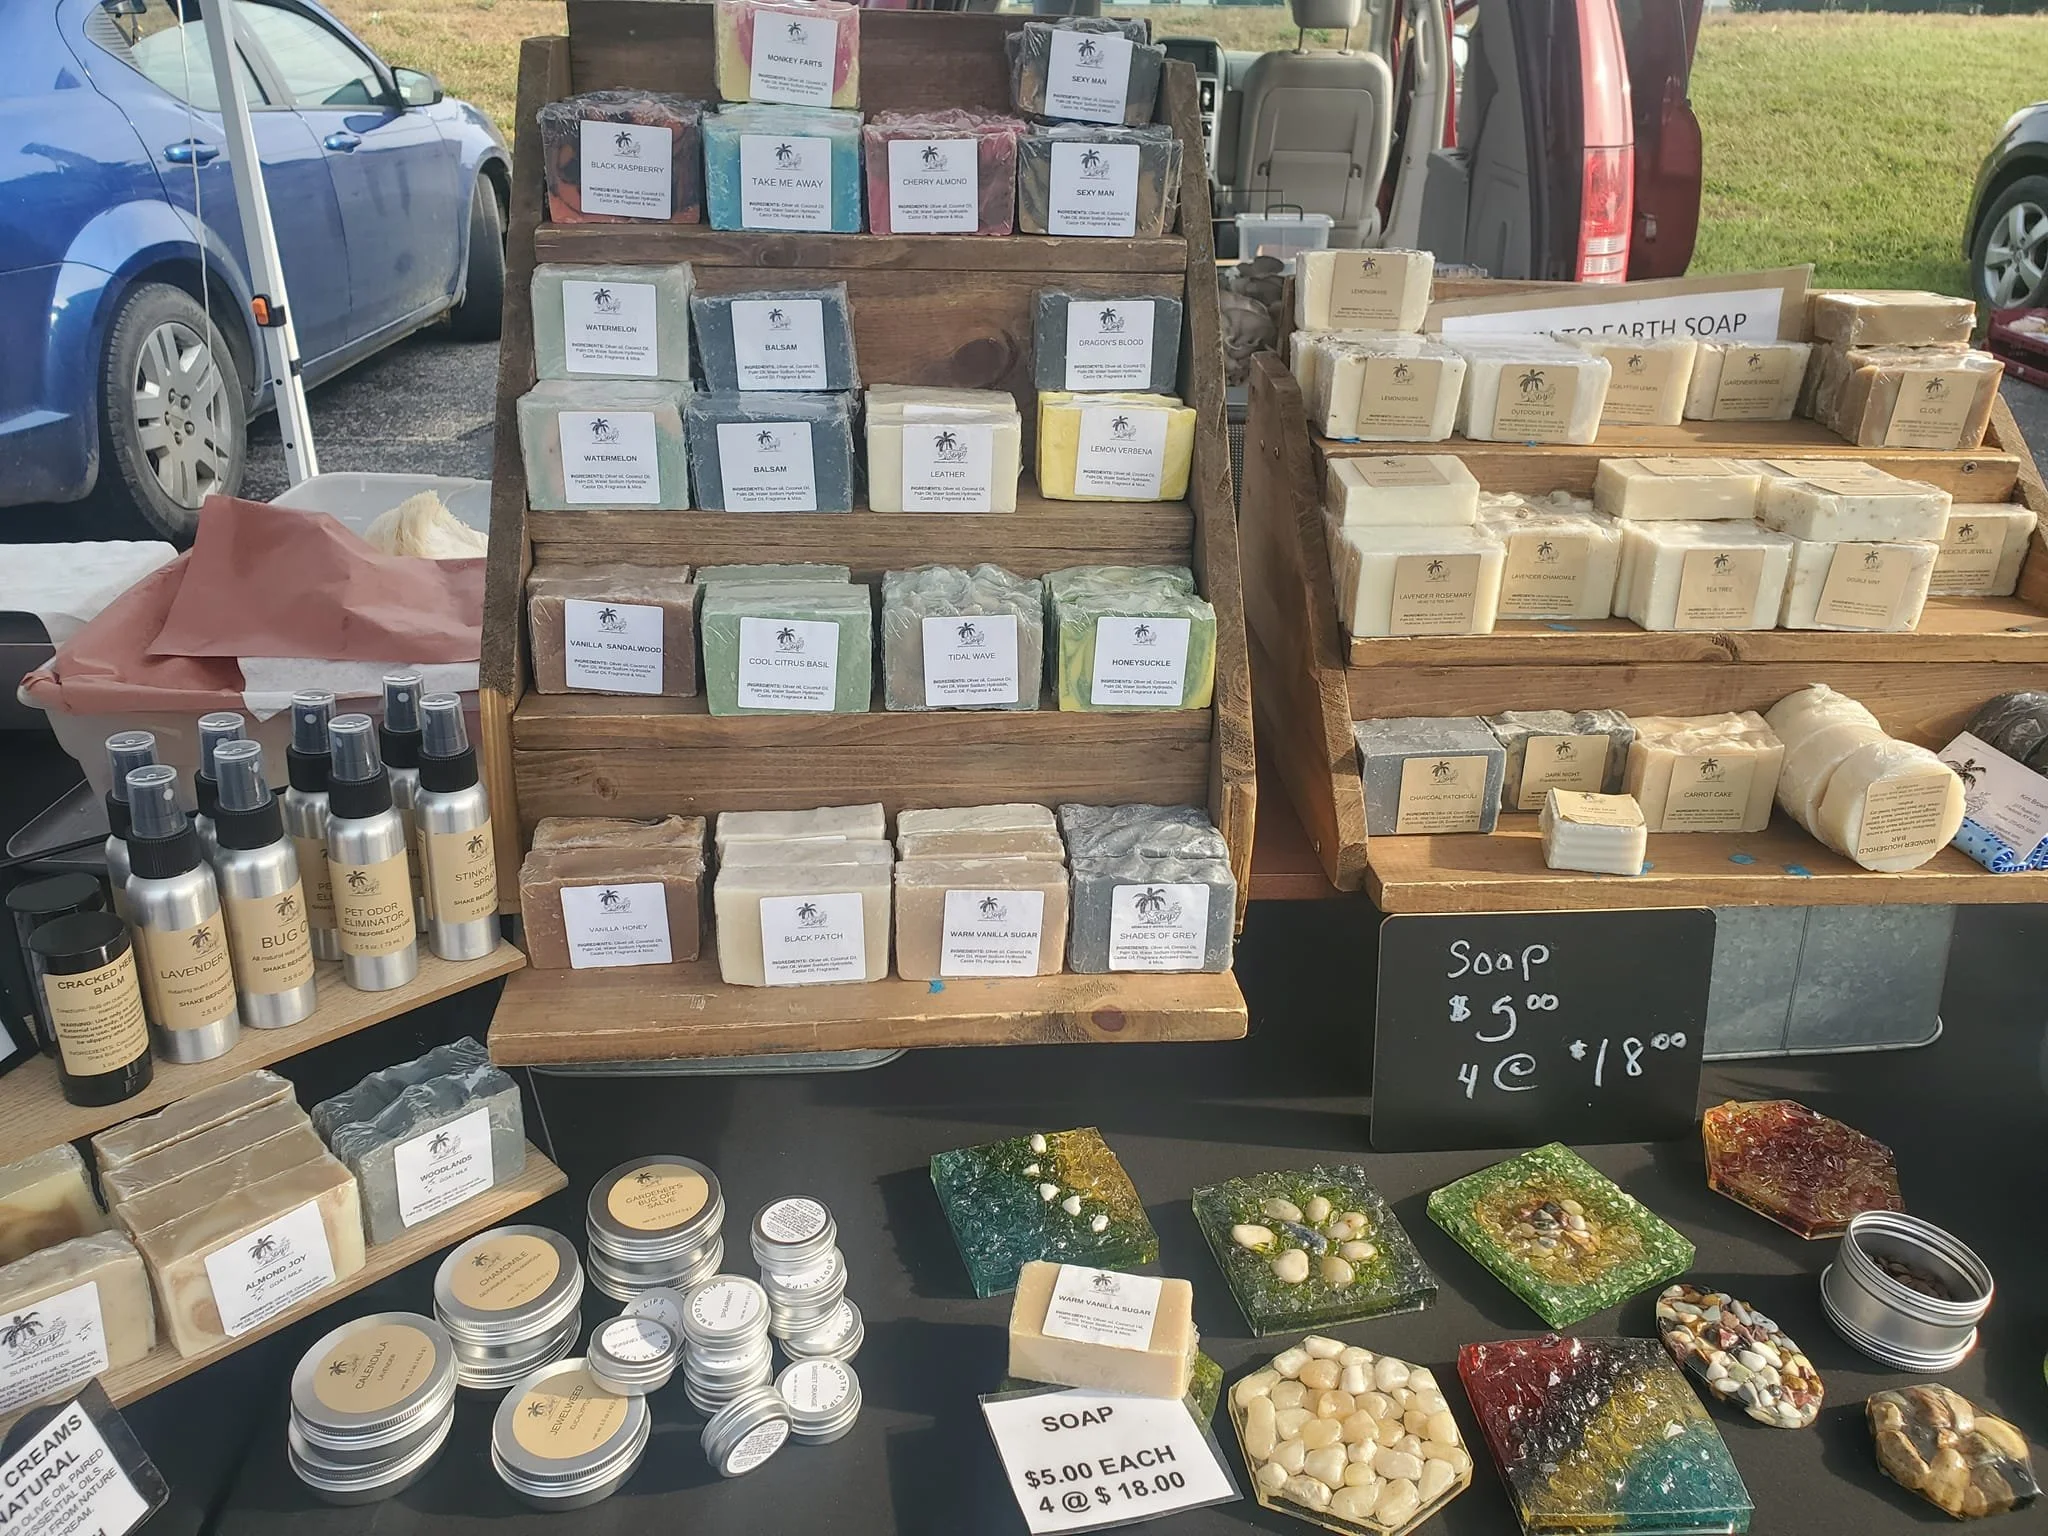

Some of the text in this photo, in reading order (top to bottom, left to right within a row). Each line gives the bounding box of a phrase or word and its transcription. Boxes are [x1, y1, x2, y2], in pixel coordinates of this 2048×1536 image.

[767, 53, 823, 68] MONKEY FARTS
[1072, 75, 1107, 86] SEXY MAN
[590, 160, 665, 174] BLACK RASPBERRY
[752, 177, 824, 189] TAKE ME AWAY
[902, 178, 968, 186] CHERRY ALMOND
[1076, 189, 1115, 198] SEXY MAN
[585, 323, 637, 334] WATERMELON
[1685, 313, 1748, 336] SOAP
[765, 343, 798, 352] BALSAM
[1078, 338, 1144, 347] DRAGON'S BLOOD
[1511, 408, 1555, 417] OUTDOOR LIFE
[1919, 407, 1943, 415] CLOVE
[583, 454, 638, 462] WATERMELON
[1090, 445, 1153, 456] LEMON VERBENA
[753, 465, 787, 473] BALSAM
[930, 470, 966, 478] LEATHER
[1399, 591, 1472, 600] LAVENDER ROSEMARY
[570, 639, 662, 654] VANILLA SANDALWOOD
[748, 657, 830, 669] COOL CITRUS BASIL
[948, 652, 996, 662] TIDAL WAVE
[1111, 658, 1171, 668] HONEYSUCKLE
[1409, 793, 1478, 802] CHARCOAL PATCHOULI
[1684, 791, 1733, 799] CARROT CAKE
[1858, 837, 1937, 855] WONDER HOUSEHOLD
[1891, 834, 1907, 843] BAR
[455, 866, 487, 883] STINKY
[344, 902, 399, 917] PET ODOR
[344, 911, 405, 929] ELIMINATOR
[358, 928, 385, 938] BEFORE
[385, 924, 402, 936] EACH
[589, 923, 648, 934] VANILLA HONEY
[950, 930, 1038, 939] WARM VANILLA SUGAR
[1118, 931, 1198, 941] SHADES OF GREY
[261, 928, 298, 949] BUG
[784, 932, 844, 944] BLACK PATCH
[160, 952, 225, 980] LAVENDER
[263, 963, 287, 973] SHAKE
[57, 968, 118, 990] CRACKED
[93, 975, 125, 996] BALM
[178, 997, 205, 1009] SHAKE
[1458, 1063, 1479, 1100] 4
[1492, 1053, 1539, 1092] @
[419, 1154, 473, 1182] WOODLANDS
[625, 1182, 684, 1205] GARDENER'S
[637, 1190, 678, 1207] BUG OFF
[646, 1197, 677, 1210] SALVE
[245, 1253, 307, 1292] ALMOND JOY
[479, 1250, 529, 1287] CHAMOMILE
[269, 1268, 304, 1289] GOAT MILK
[1058, 1295, 1152, 1317] WARM VANILLA SUGAR
[9, 1349, 70, 1378] SUNNY HERBS
[355, 1340, 389, 1390] CALENDULA
[821, 1362, 848, 1410] SMOOTH LIPS
[549, 1384, 585, 1436] JEWELWEED
[1041, 1405, 1114, 1433] SOAP
[4, 1414, 83, 1488] CREAMS
[1024, 1445, 1177, 1490] $5.00 EACH
[78, 1466, 105, 1491] OILS.
[20, 1448, 104, 1528] OLIVE OIL PAIRED
[1039, 1471, 1186, 1514] 4 @ $ 18.00
[48, 1466, 118, 1535] FROM NATURE
